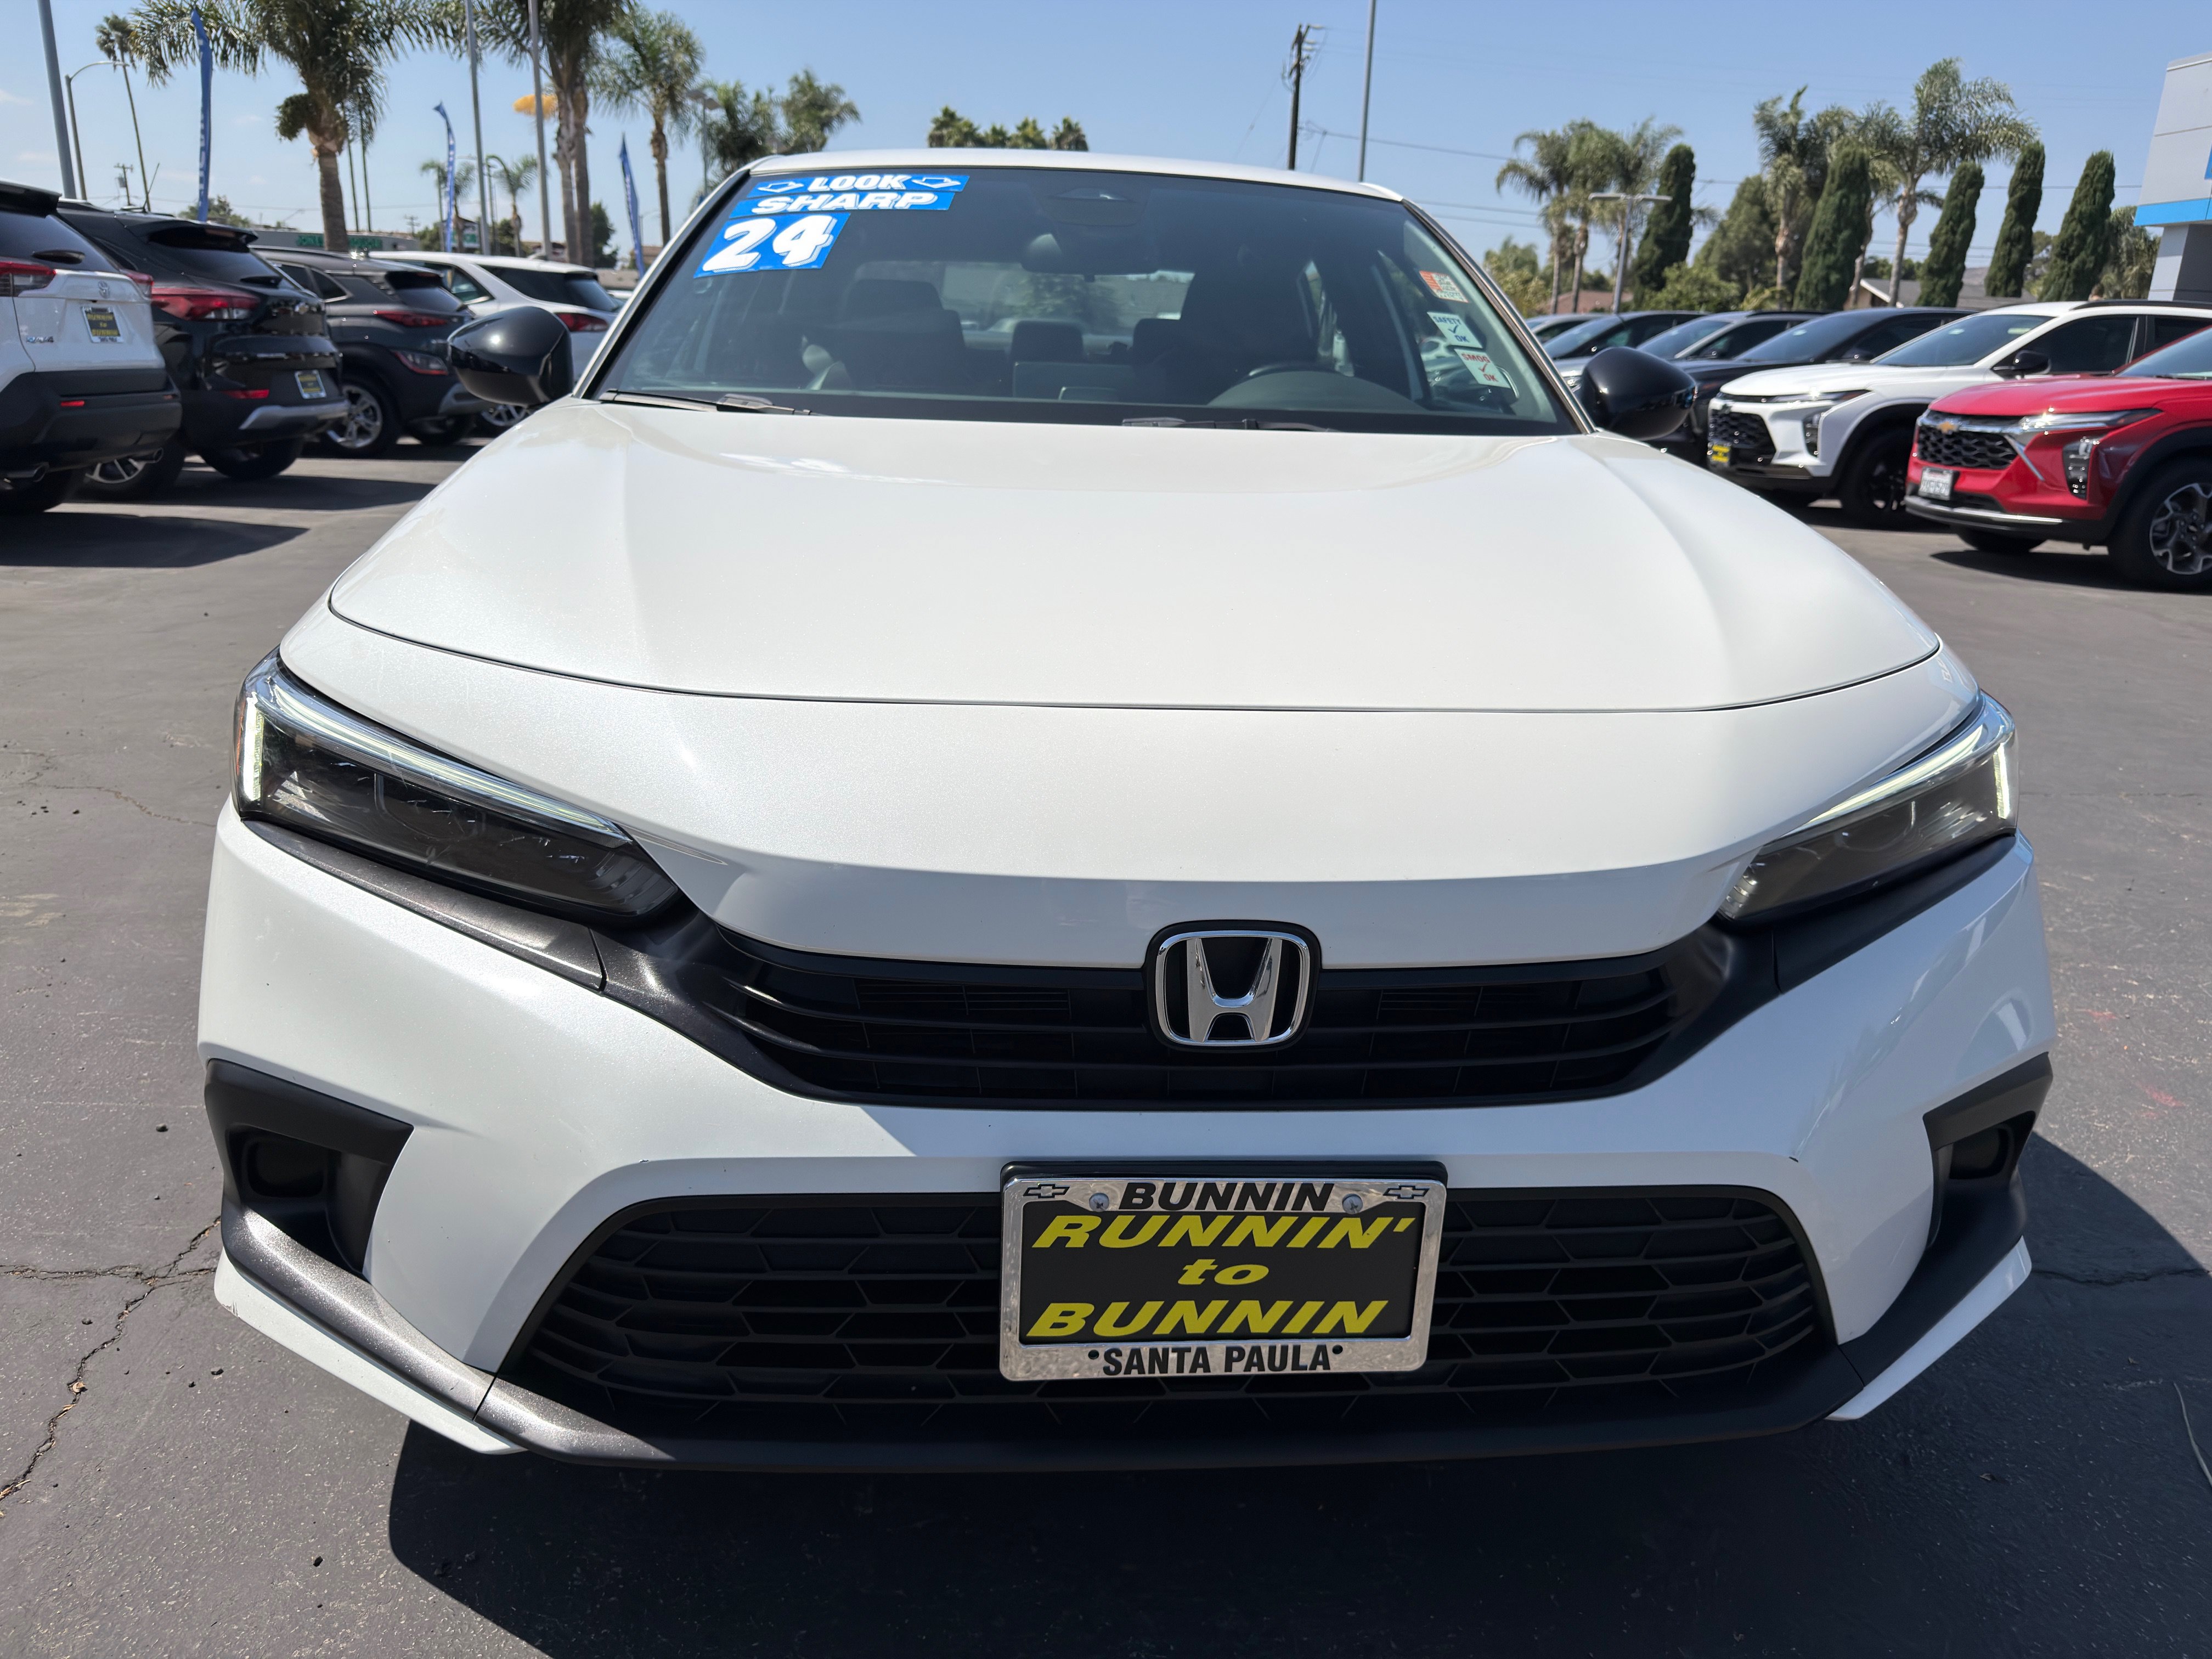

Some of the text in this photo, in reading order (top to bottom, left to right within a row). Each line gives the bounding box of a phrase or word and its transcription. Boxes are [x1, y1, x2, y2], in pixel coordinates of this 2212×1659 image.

[808, 174, 912, 192] LOOK
[752, 192, 938, 213] SHARP
[702, 215, 837, 273] 24
[1432, 316, 1462, 325] SAFETY
[1455, 335, 1470, 343] OK
[1462, 353, 1491, 363] SMOG
[1483, 374, 1499, 382] OK
[1118, 1182, 1334, 1211] BUNNIN
[1031, 1214, 1416, 1249] RUNNIN'
[1177, 1259, 1269, 1285] to
[1026, 1300, 1389, 1337] BUNNIN
[1103, 1344, 1331, 1376] SANTA PAULA
